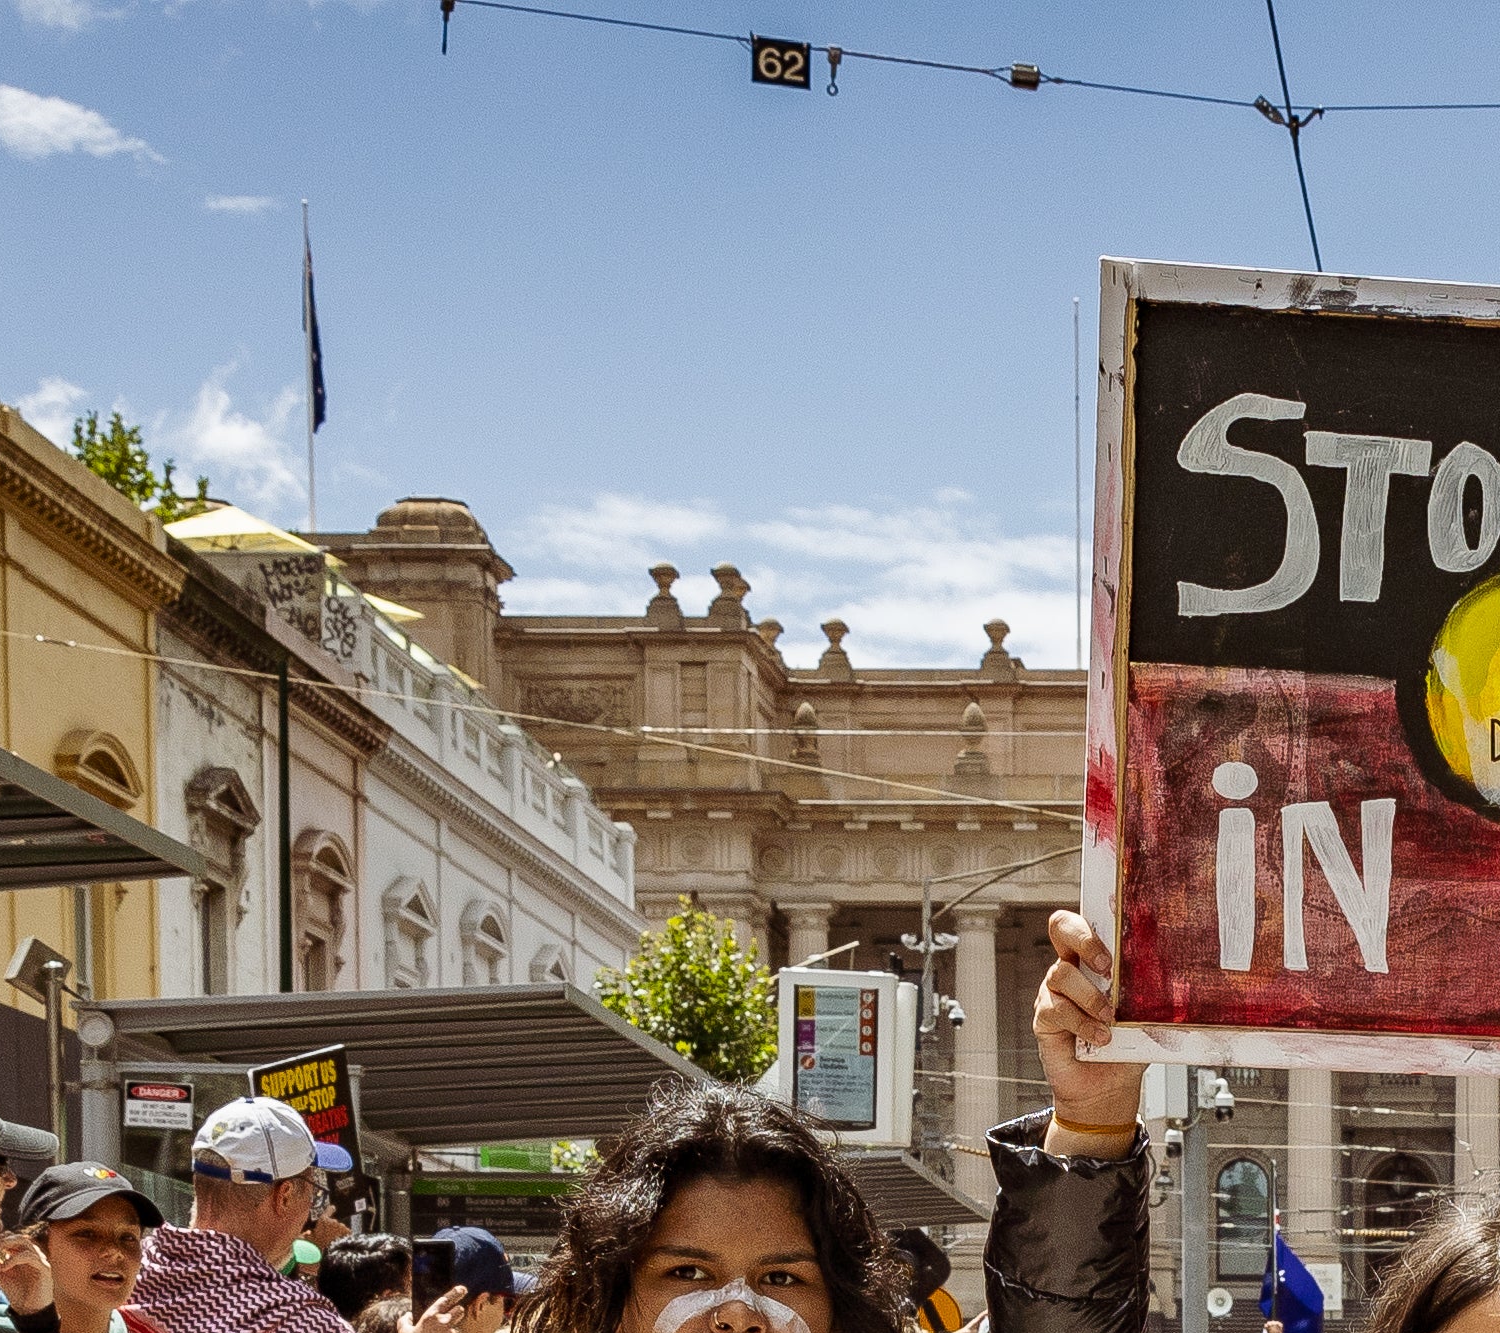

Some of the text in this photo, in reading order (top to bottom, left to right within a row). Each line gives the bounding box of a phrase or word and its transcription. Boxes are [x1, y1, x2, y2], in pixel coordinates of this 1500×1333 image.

[759, 47, 804, 81] 62
[261, 1059, 337, 1098] SUPPORT US
[308, 1085, 336, 1112] STOP
